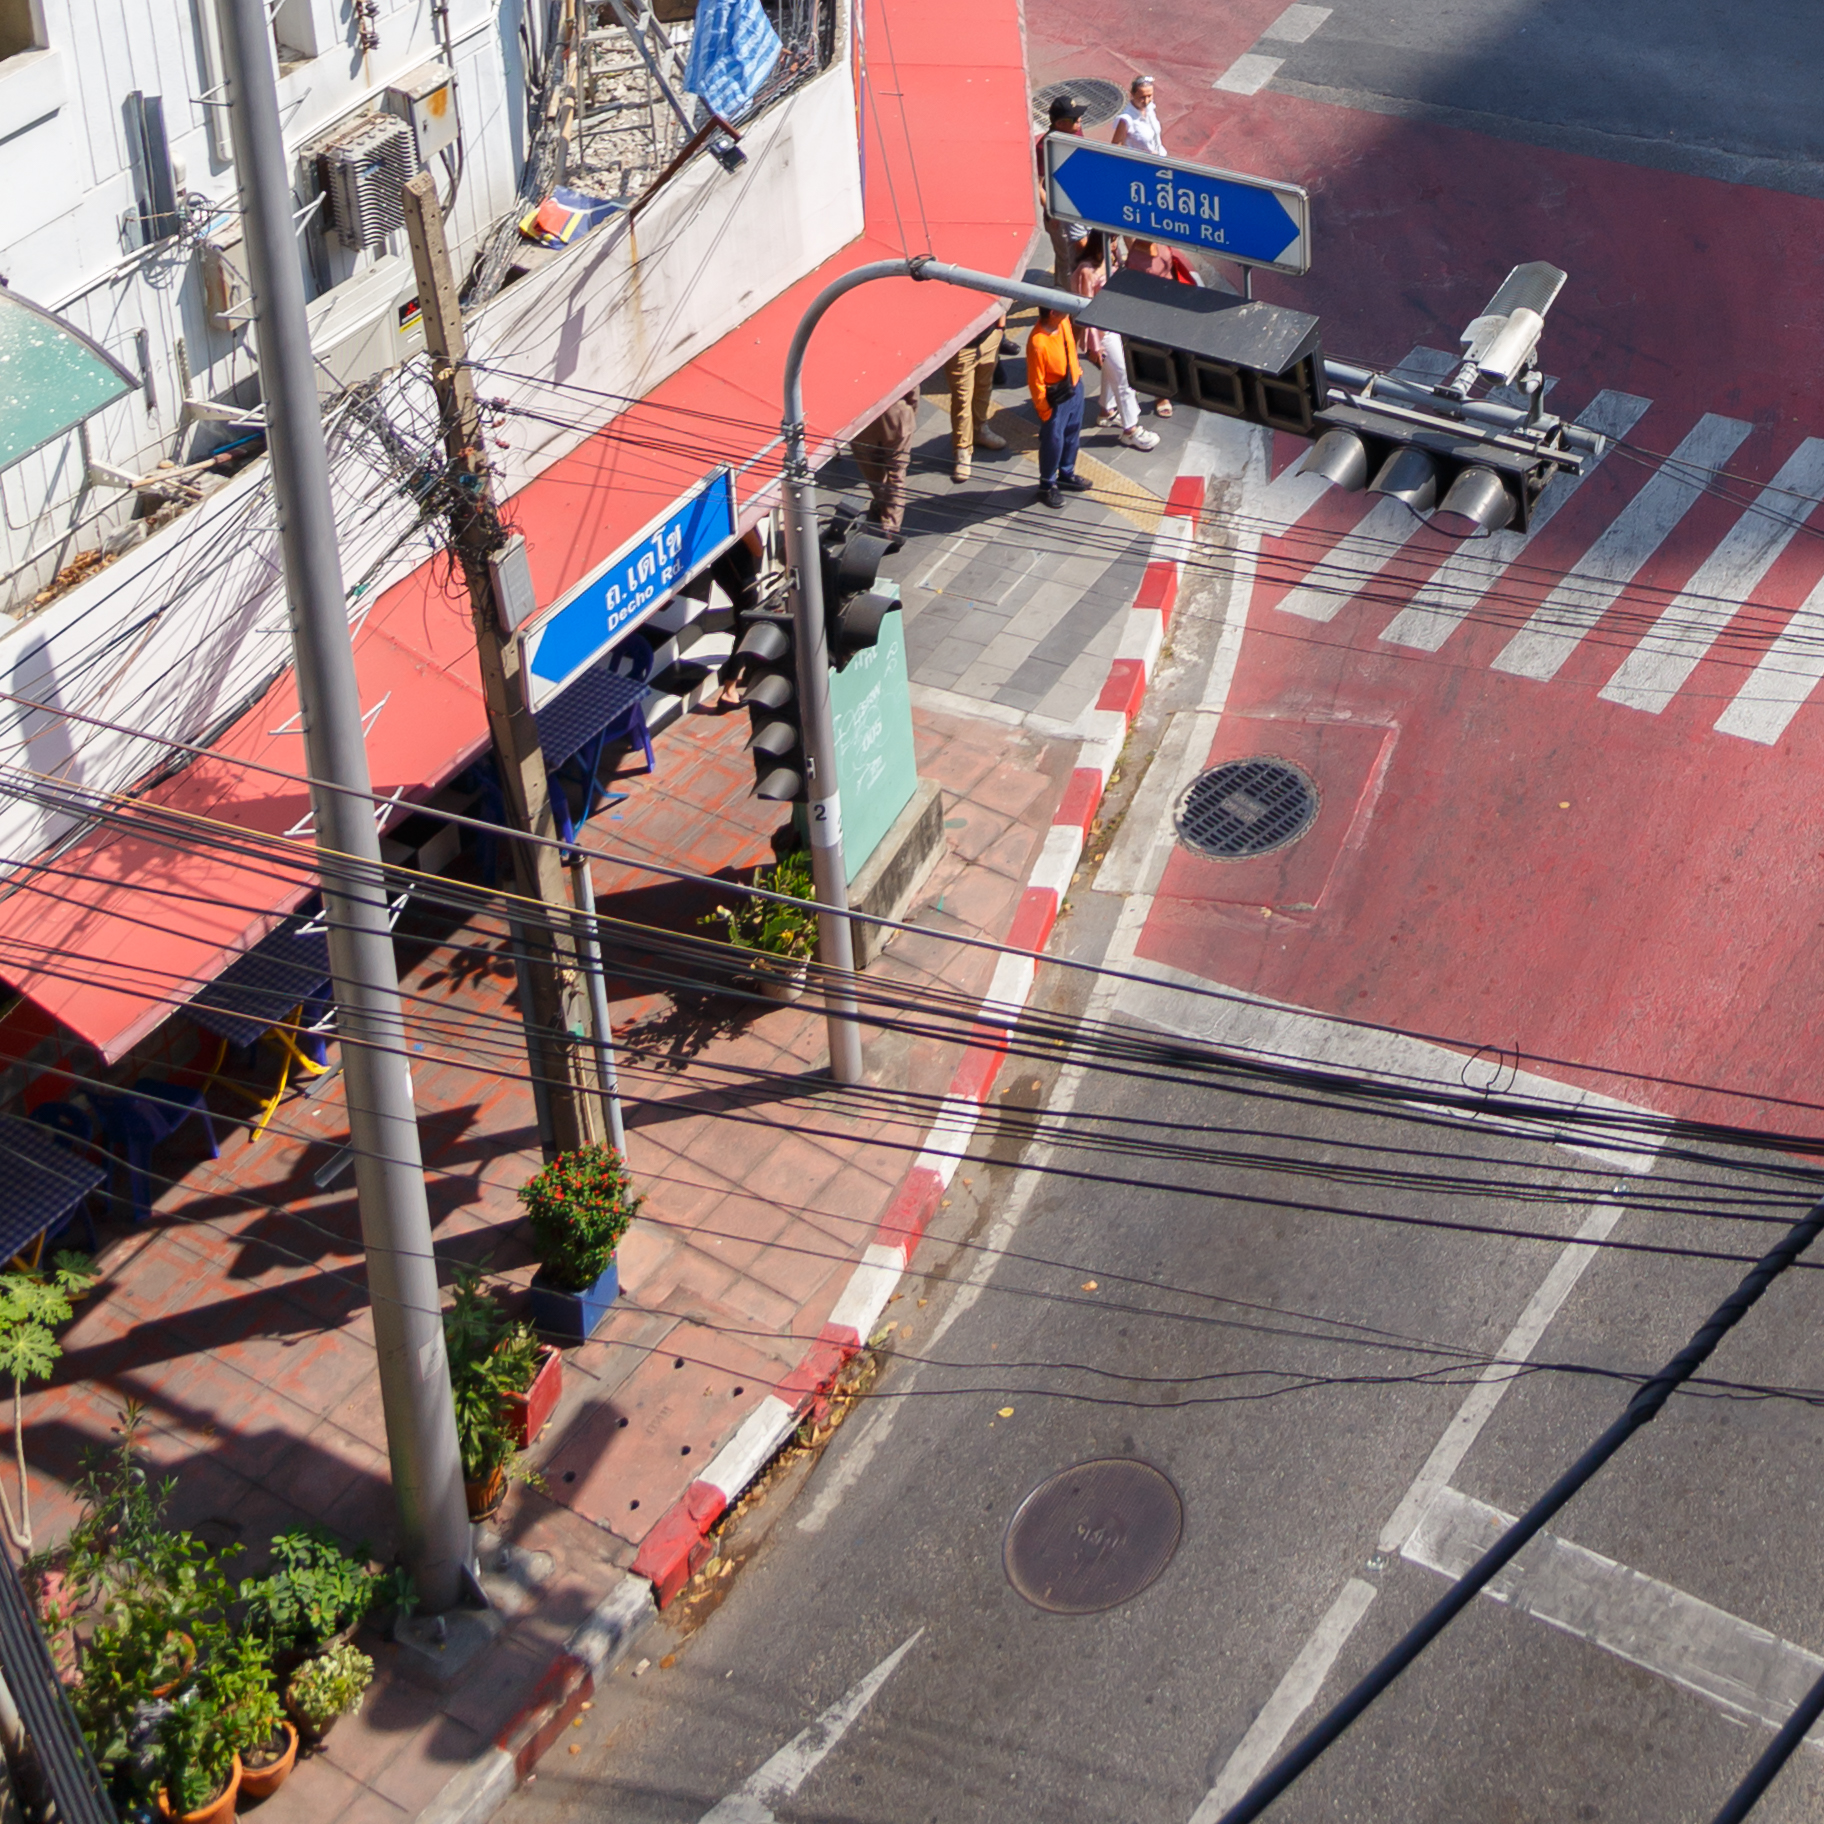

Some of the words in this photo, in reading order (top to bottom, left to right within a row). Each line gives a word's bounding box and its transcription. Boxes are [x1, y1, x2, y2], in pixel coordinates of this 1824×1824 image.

[1130, 169, 1220, 222] ถ.สีลม
[1123, 205, 1141, 224] Si
[1151, 212, 1190, 235] Lom
[1201, 224, 1230, 245] Rd.
[605, 523, 682, 611] ถ.เดโช
[608, 585, 654, 632] Decho
[661, 558, 684, 585] Rd.
[813, 804, 828, 822] 2
